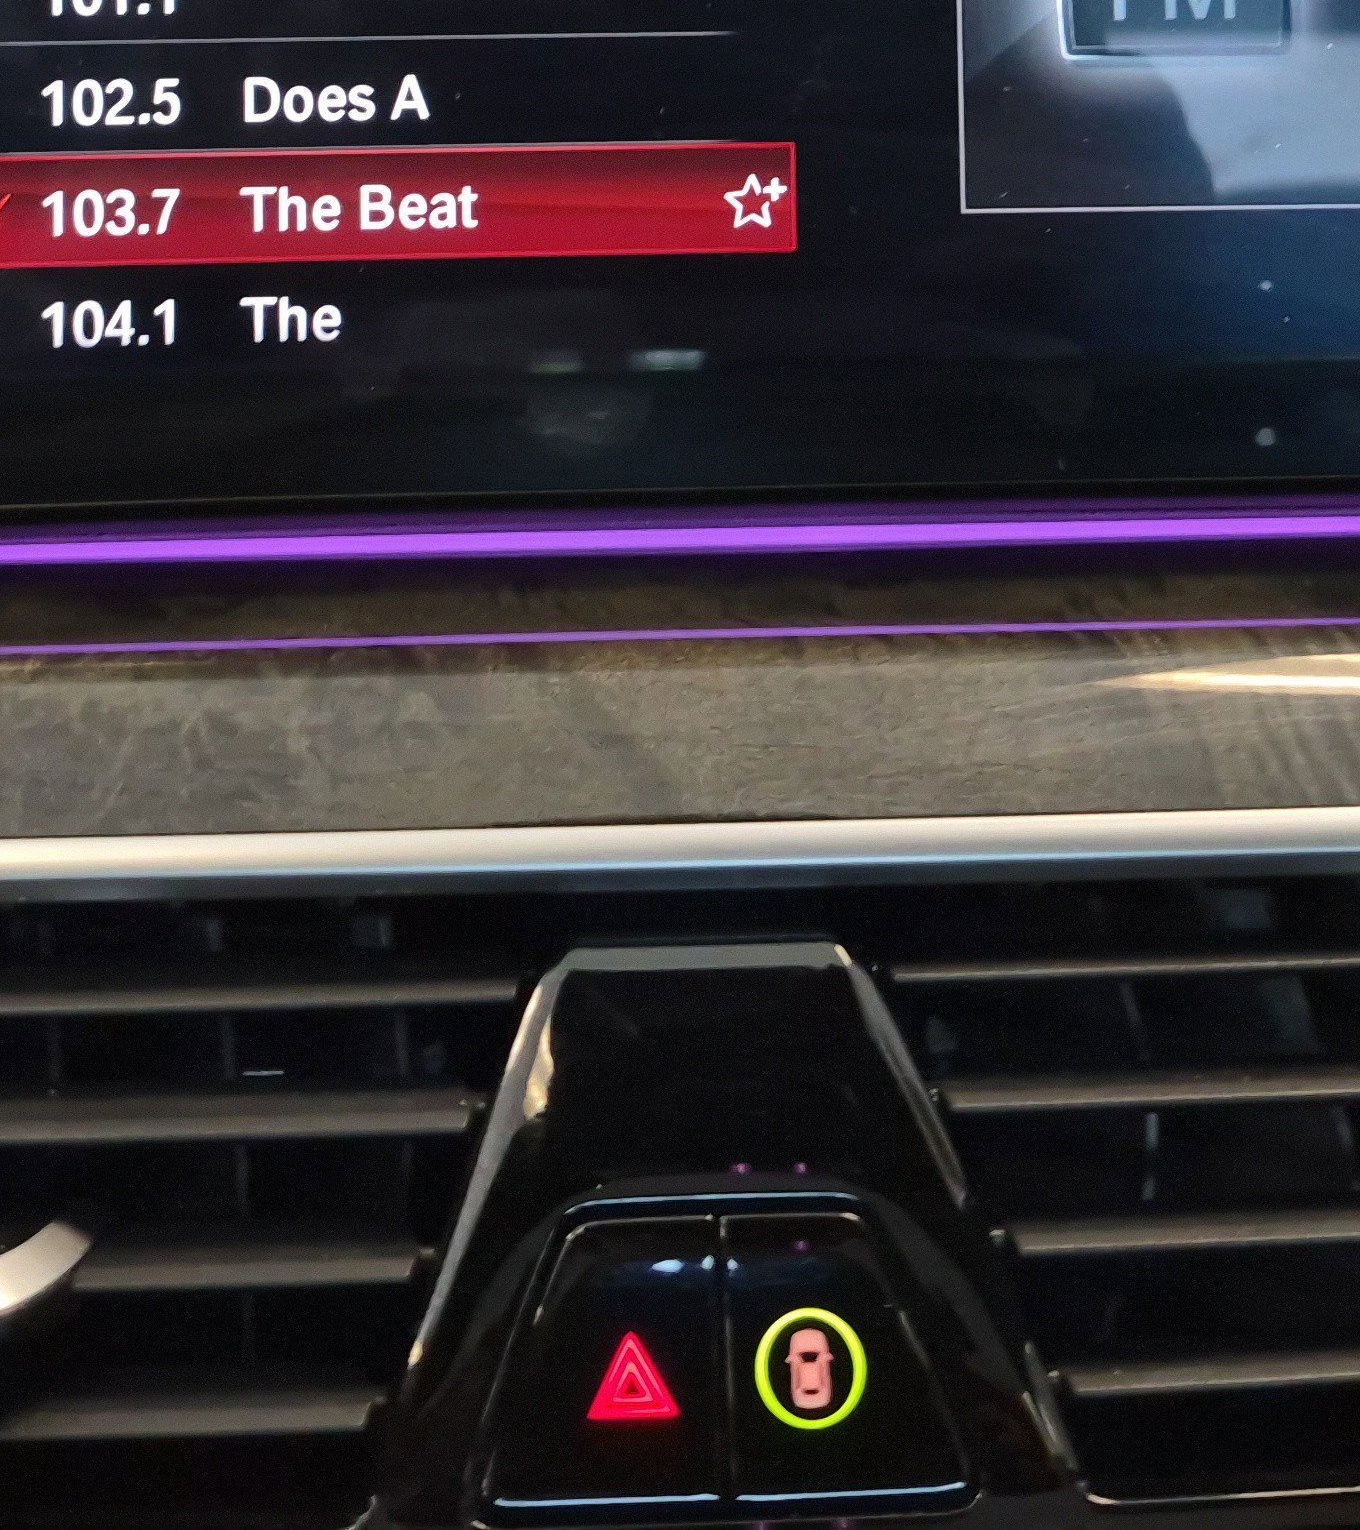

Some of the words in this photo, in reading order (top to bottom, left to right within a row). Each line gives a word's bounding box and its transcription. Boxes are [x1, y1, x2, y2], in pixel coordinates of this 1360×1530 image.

[40, 77, 183, 127] 102.5
[242, 76, 377, 123] Does
[390, 73, 431, 121] A
[40, 187, 181, 239] 103.7
[239, 185, 342, 234] The
[358, 183, 480, 232] Beat
[40, 298, 178, 349] 104.1
[239, 295, 342, 343] The
